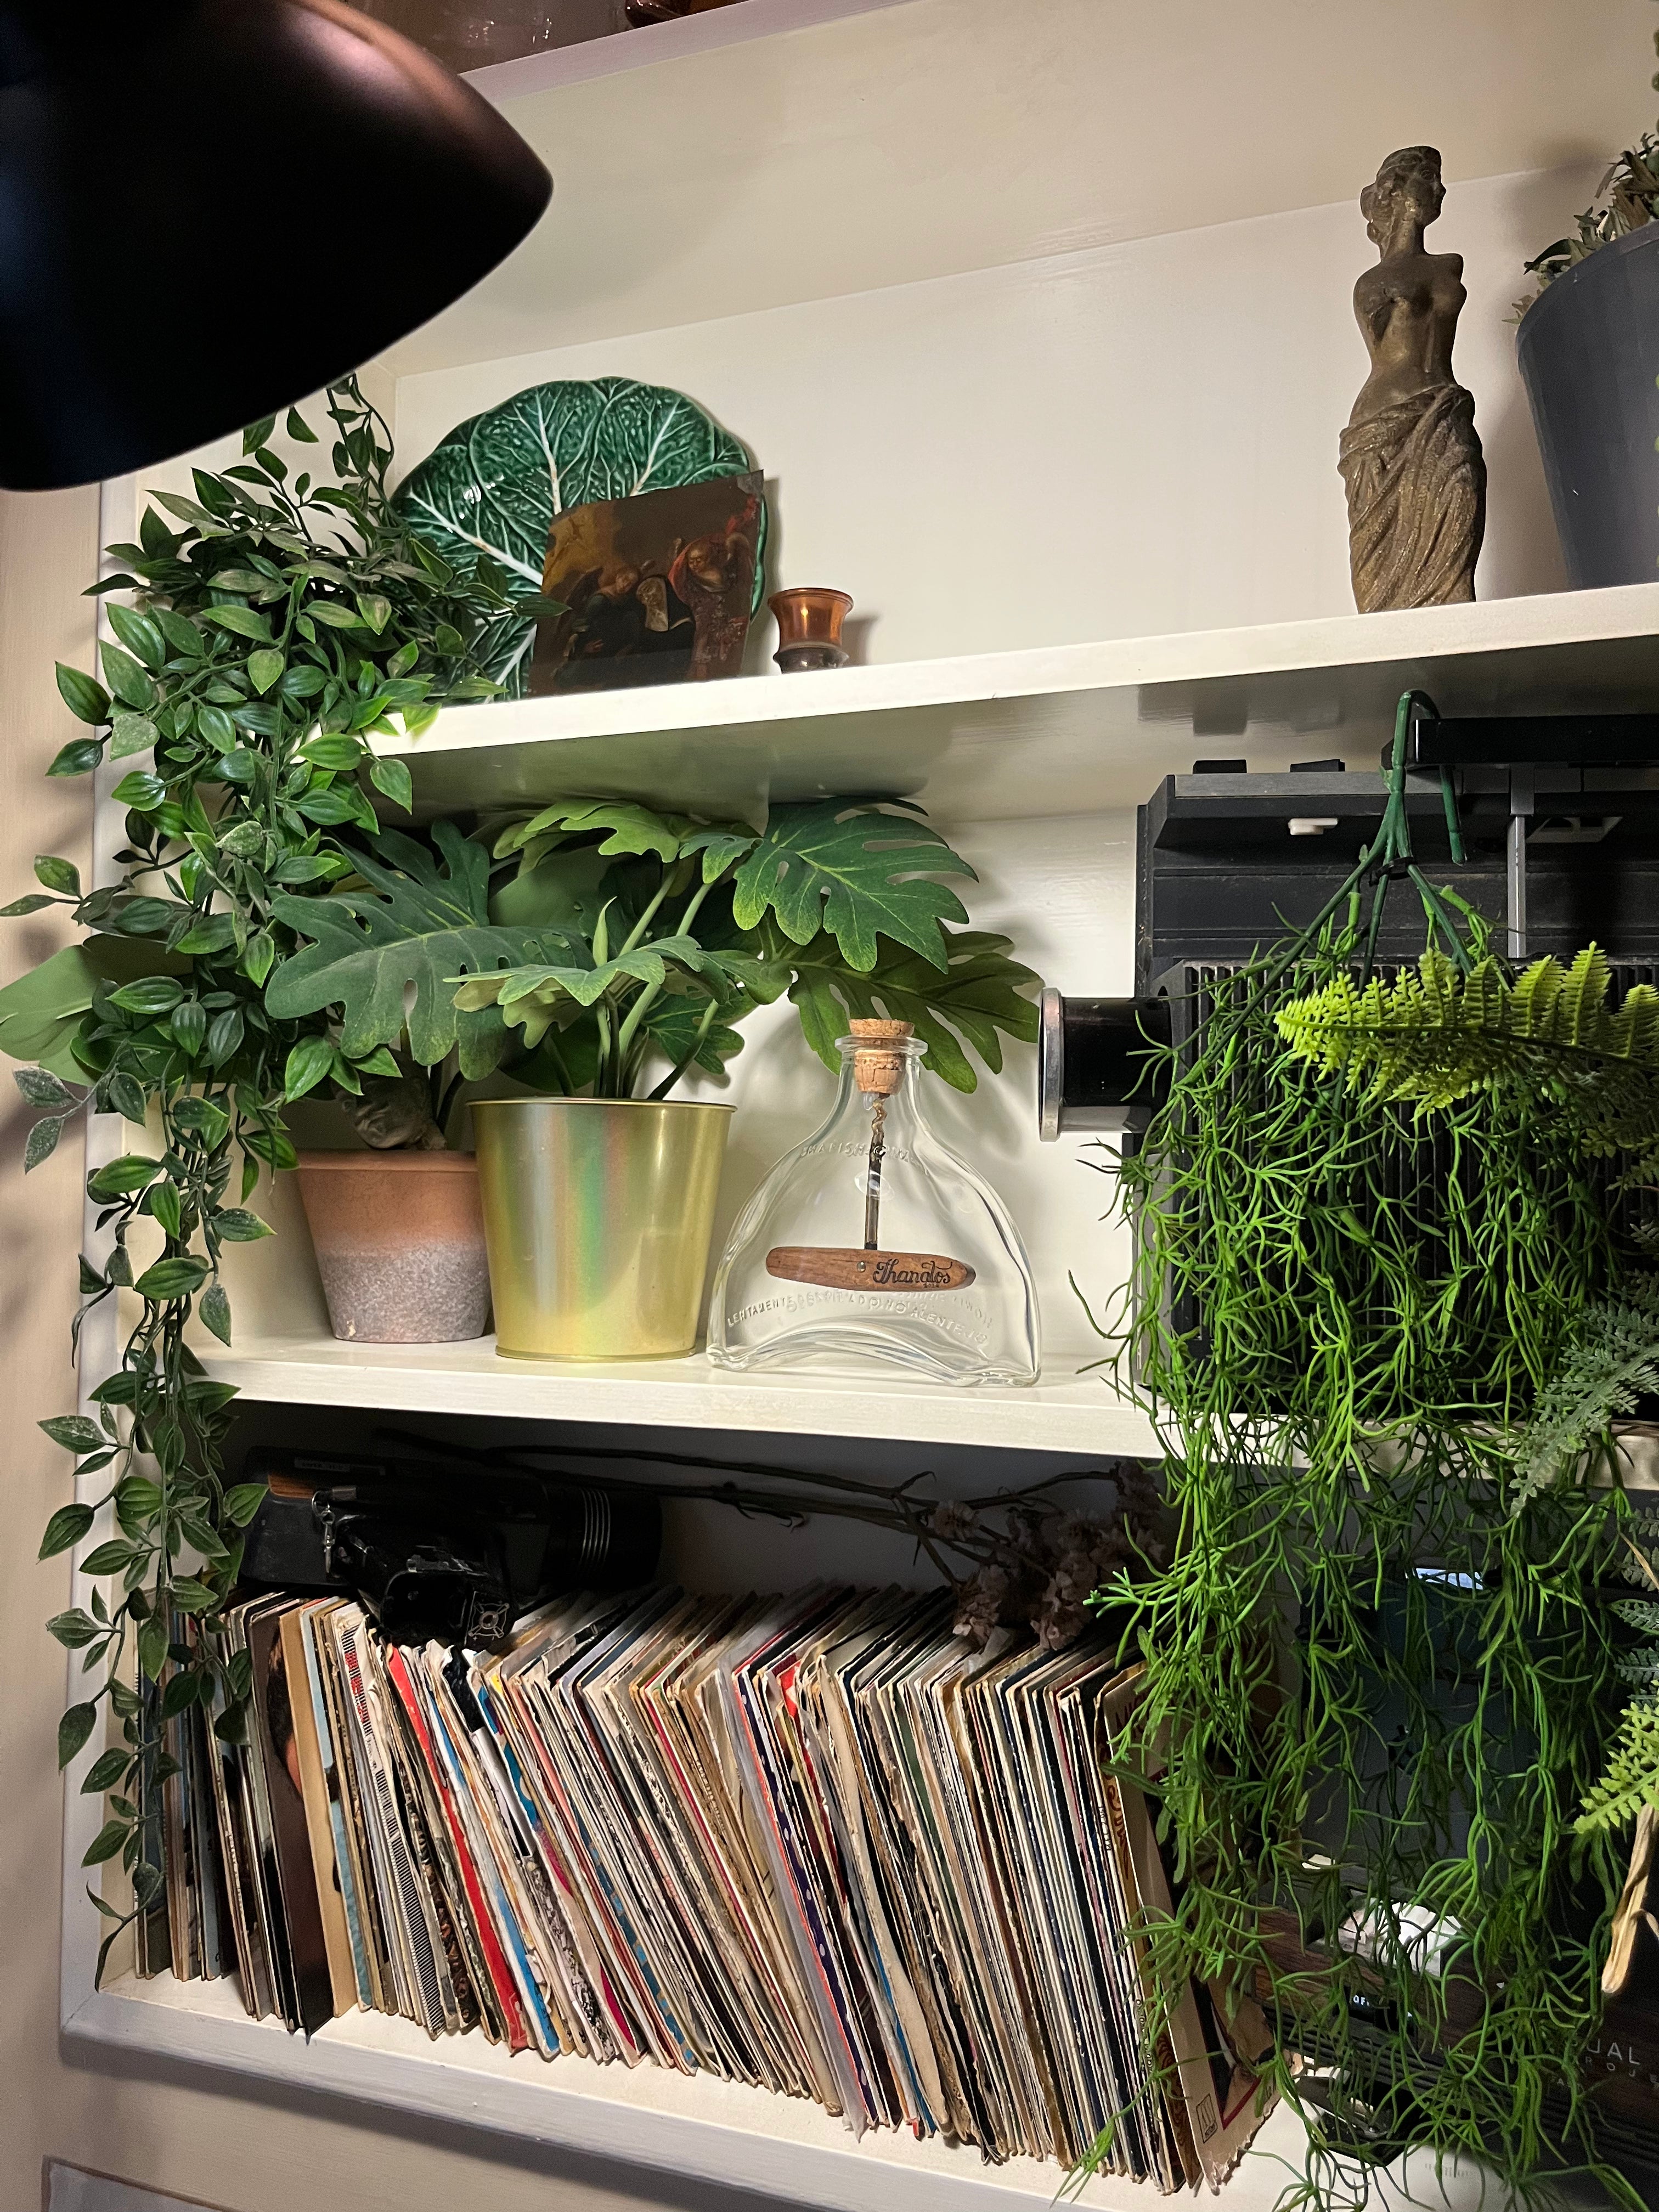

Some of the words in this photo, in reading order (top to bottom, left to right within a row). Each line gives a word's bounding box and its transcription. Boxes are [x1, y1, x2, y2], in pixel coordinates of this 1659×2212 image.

[872, 1259, 953, 1284] Thanatos
[910, 1307, 988, 1344] ALENTEJO
[1353, 1994, 1370, 2007] OF
[1570, 2033, 1640, 2066] UAL
